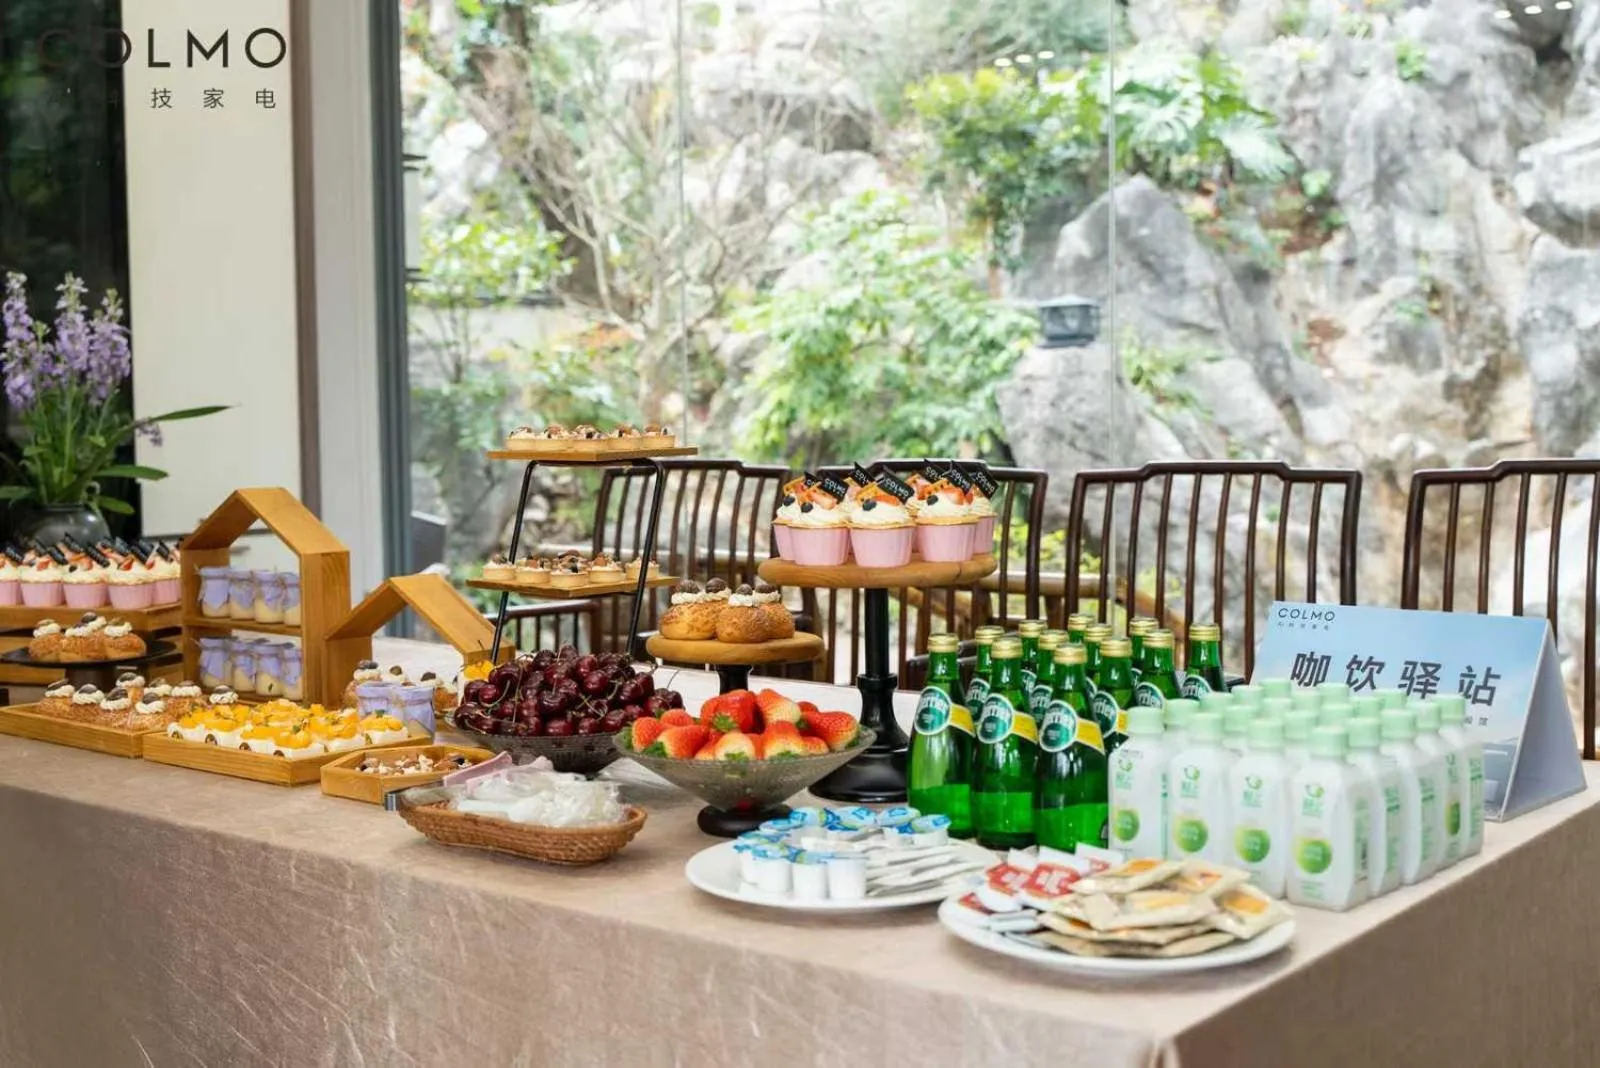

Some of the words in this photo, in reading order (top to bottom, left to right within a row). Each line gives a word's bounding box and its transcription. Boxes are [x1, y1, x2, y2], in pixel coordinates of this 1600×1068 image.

[1278, 607, 1336, 622] COLMO
[1290, 651, 1501, 706] 咖饮驿站
